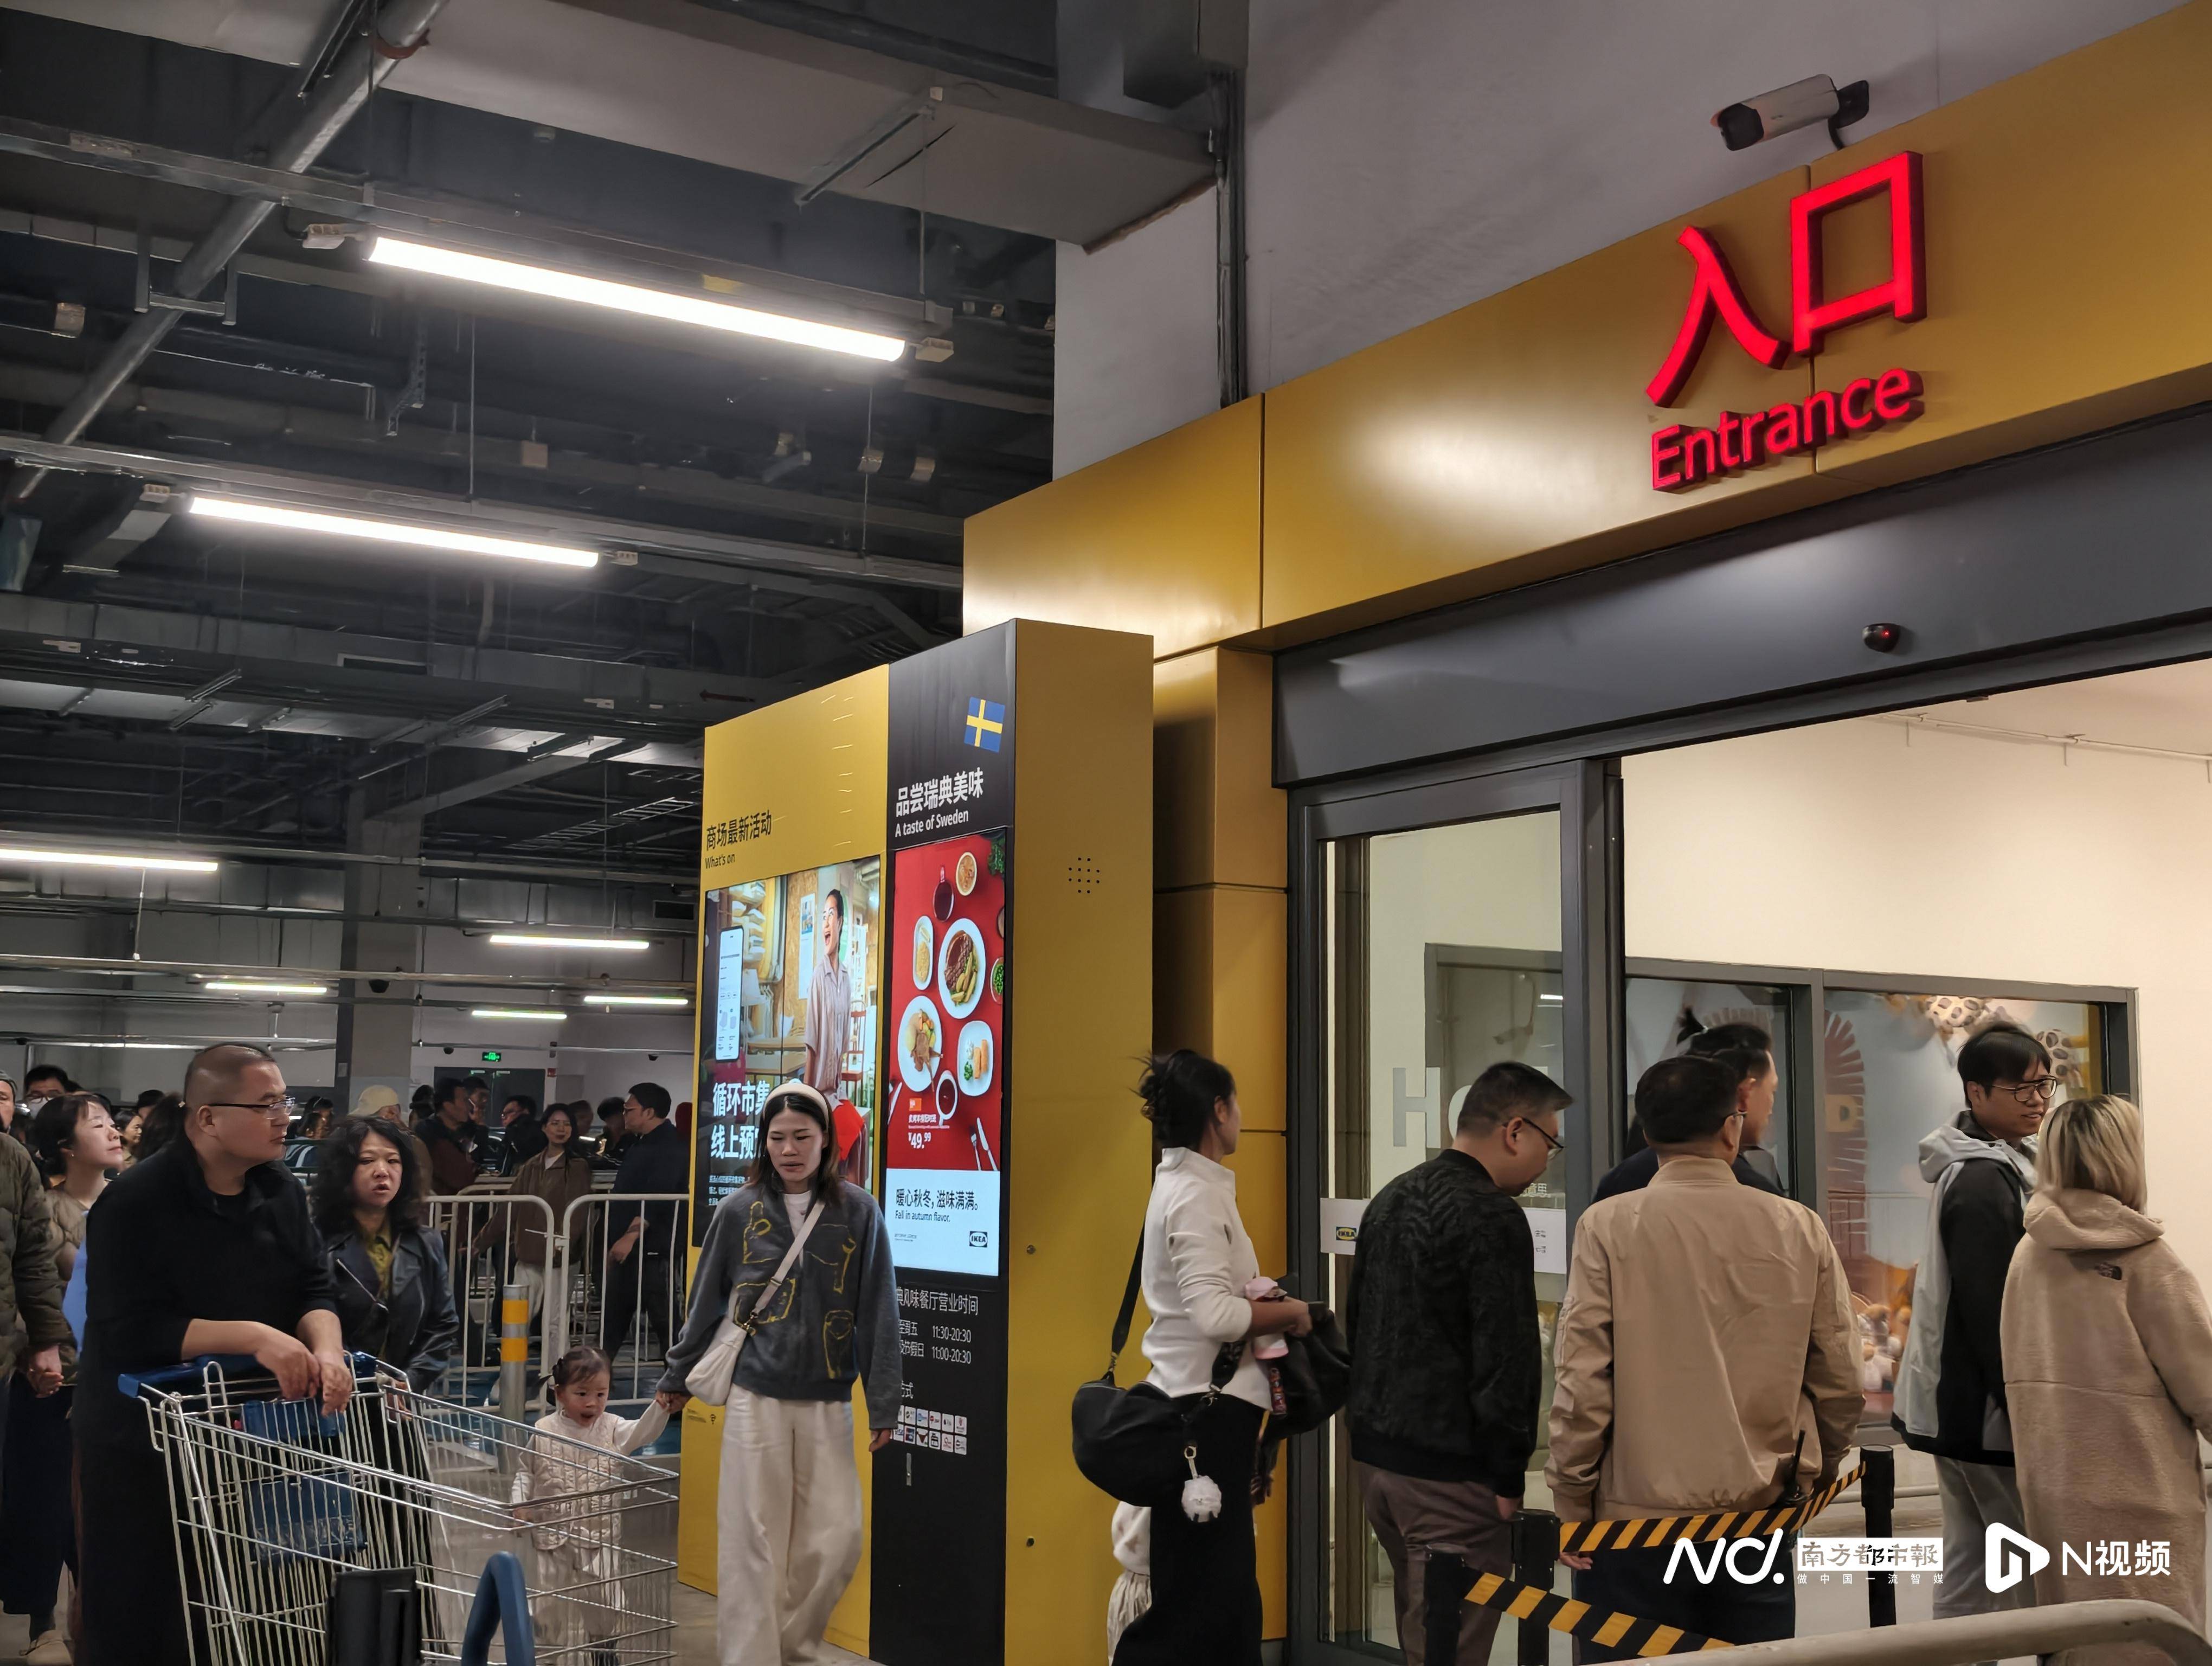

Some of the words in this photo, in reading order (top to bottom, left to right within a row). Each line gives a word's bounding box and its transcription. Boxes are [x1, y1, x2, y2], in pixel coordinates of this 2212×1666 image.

[1646, 150, 1927, 409] 入口
[1651, 367, 1925, 494] Entrance
[896, 767, 984, 817] 品尝瑞典美味
[706, 809, 772, 852] 商场最新活动
[895, 823, 902, 837] A
[903, 819, 924, 836] taste
[925, 814, 935, 831] of
[936, 809, 969, 829] Sweden
[705, 855, 726, 869] What's
[727, 854, 736, 864] on
[711, 1124, 760, 1160] 线上预
[895, 1210, 904, 1219] Fall
[905, 1210, 911, 1220] in
[912, 1212, 933, 1221] autumn
[970, 1235, 986, 1243] IKEA
[933, 1325, 972, 1343] 11:30-20:30
[932, 1345, 972, 1364] 11:00-20:30
